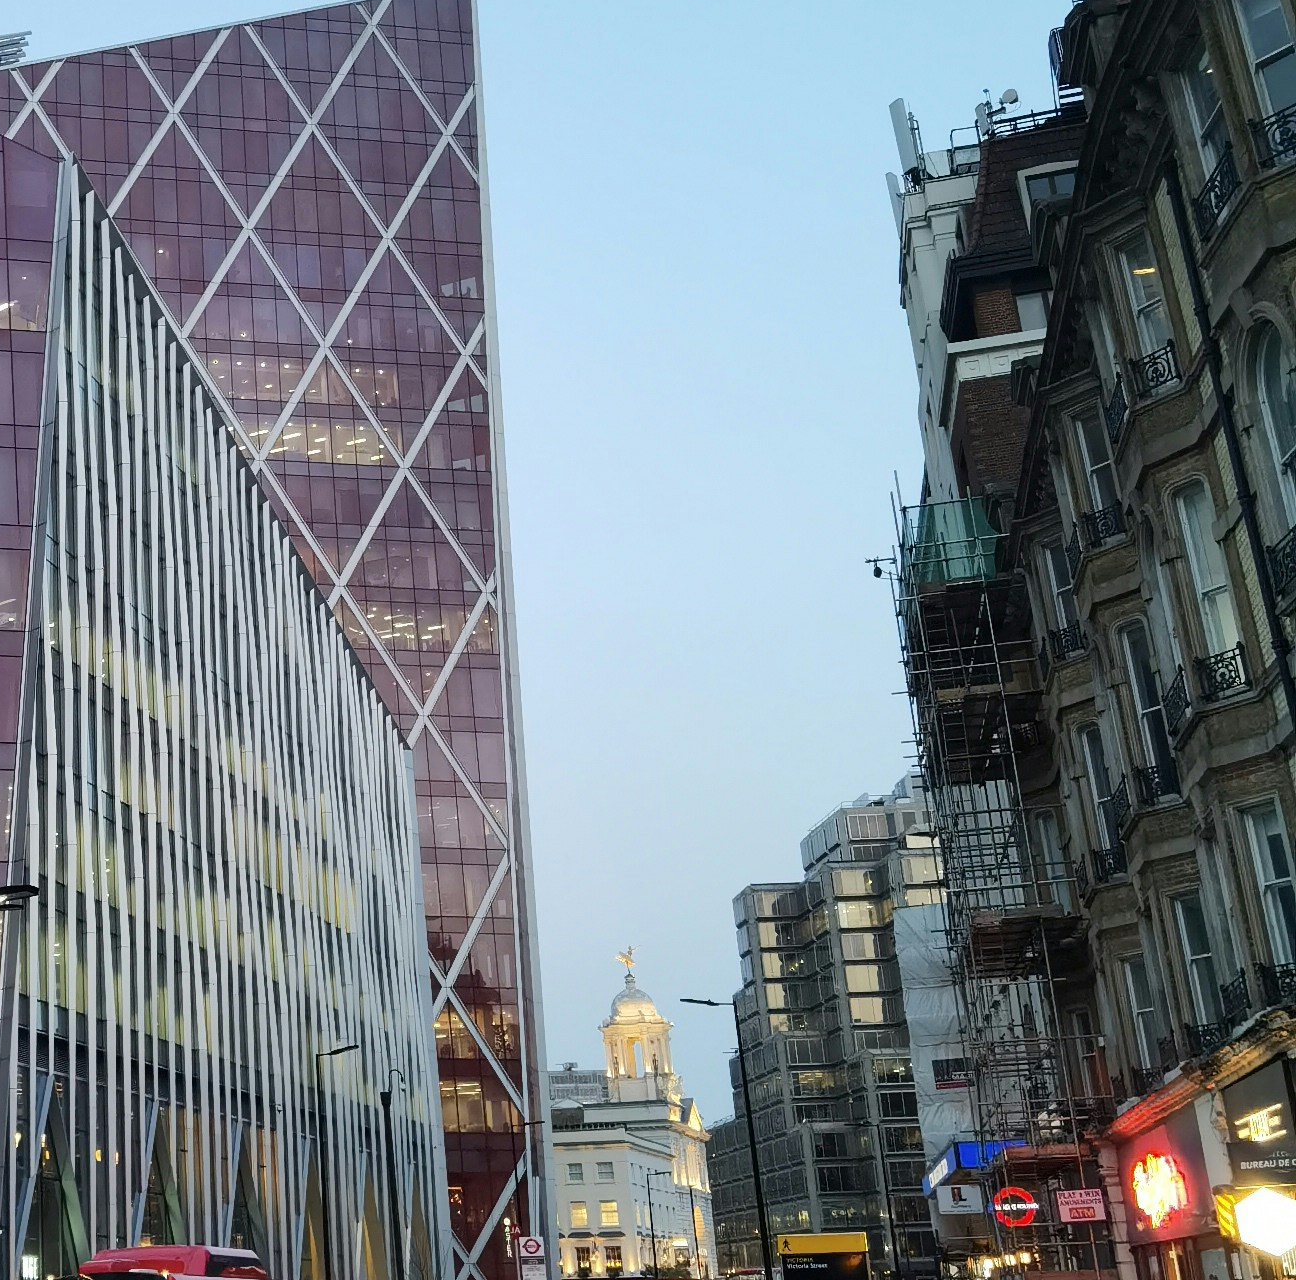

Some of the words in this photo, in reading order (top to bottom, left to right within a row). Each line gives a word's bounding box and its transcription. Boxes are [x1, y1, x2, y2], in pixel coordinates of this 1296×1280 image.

[1240, 1158, 1277, 1170] BUREAU
[1070, 1208, 1095, 1218] ATM
[504, 1225, 513, 1258] ASTER
